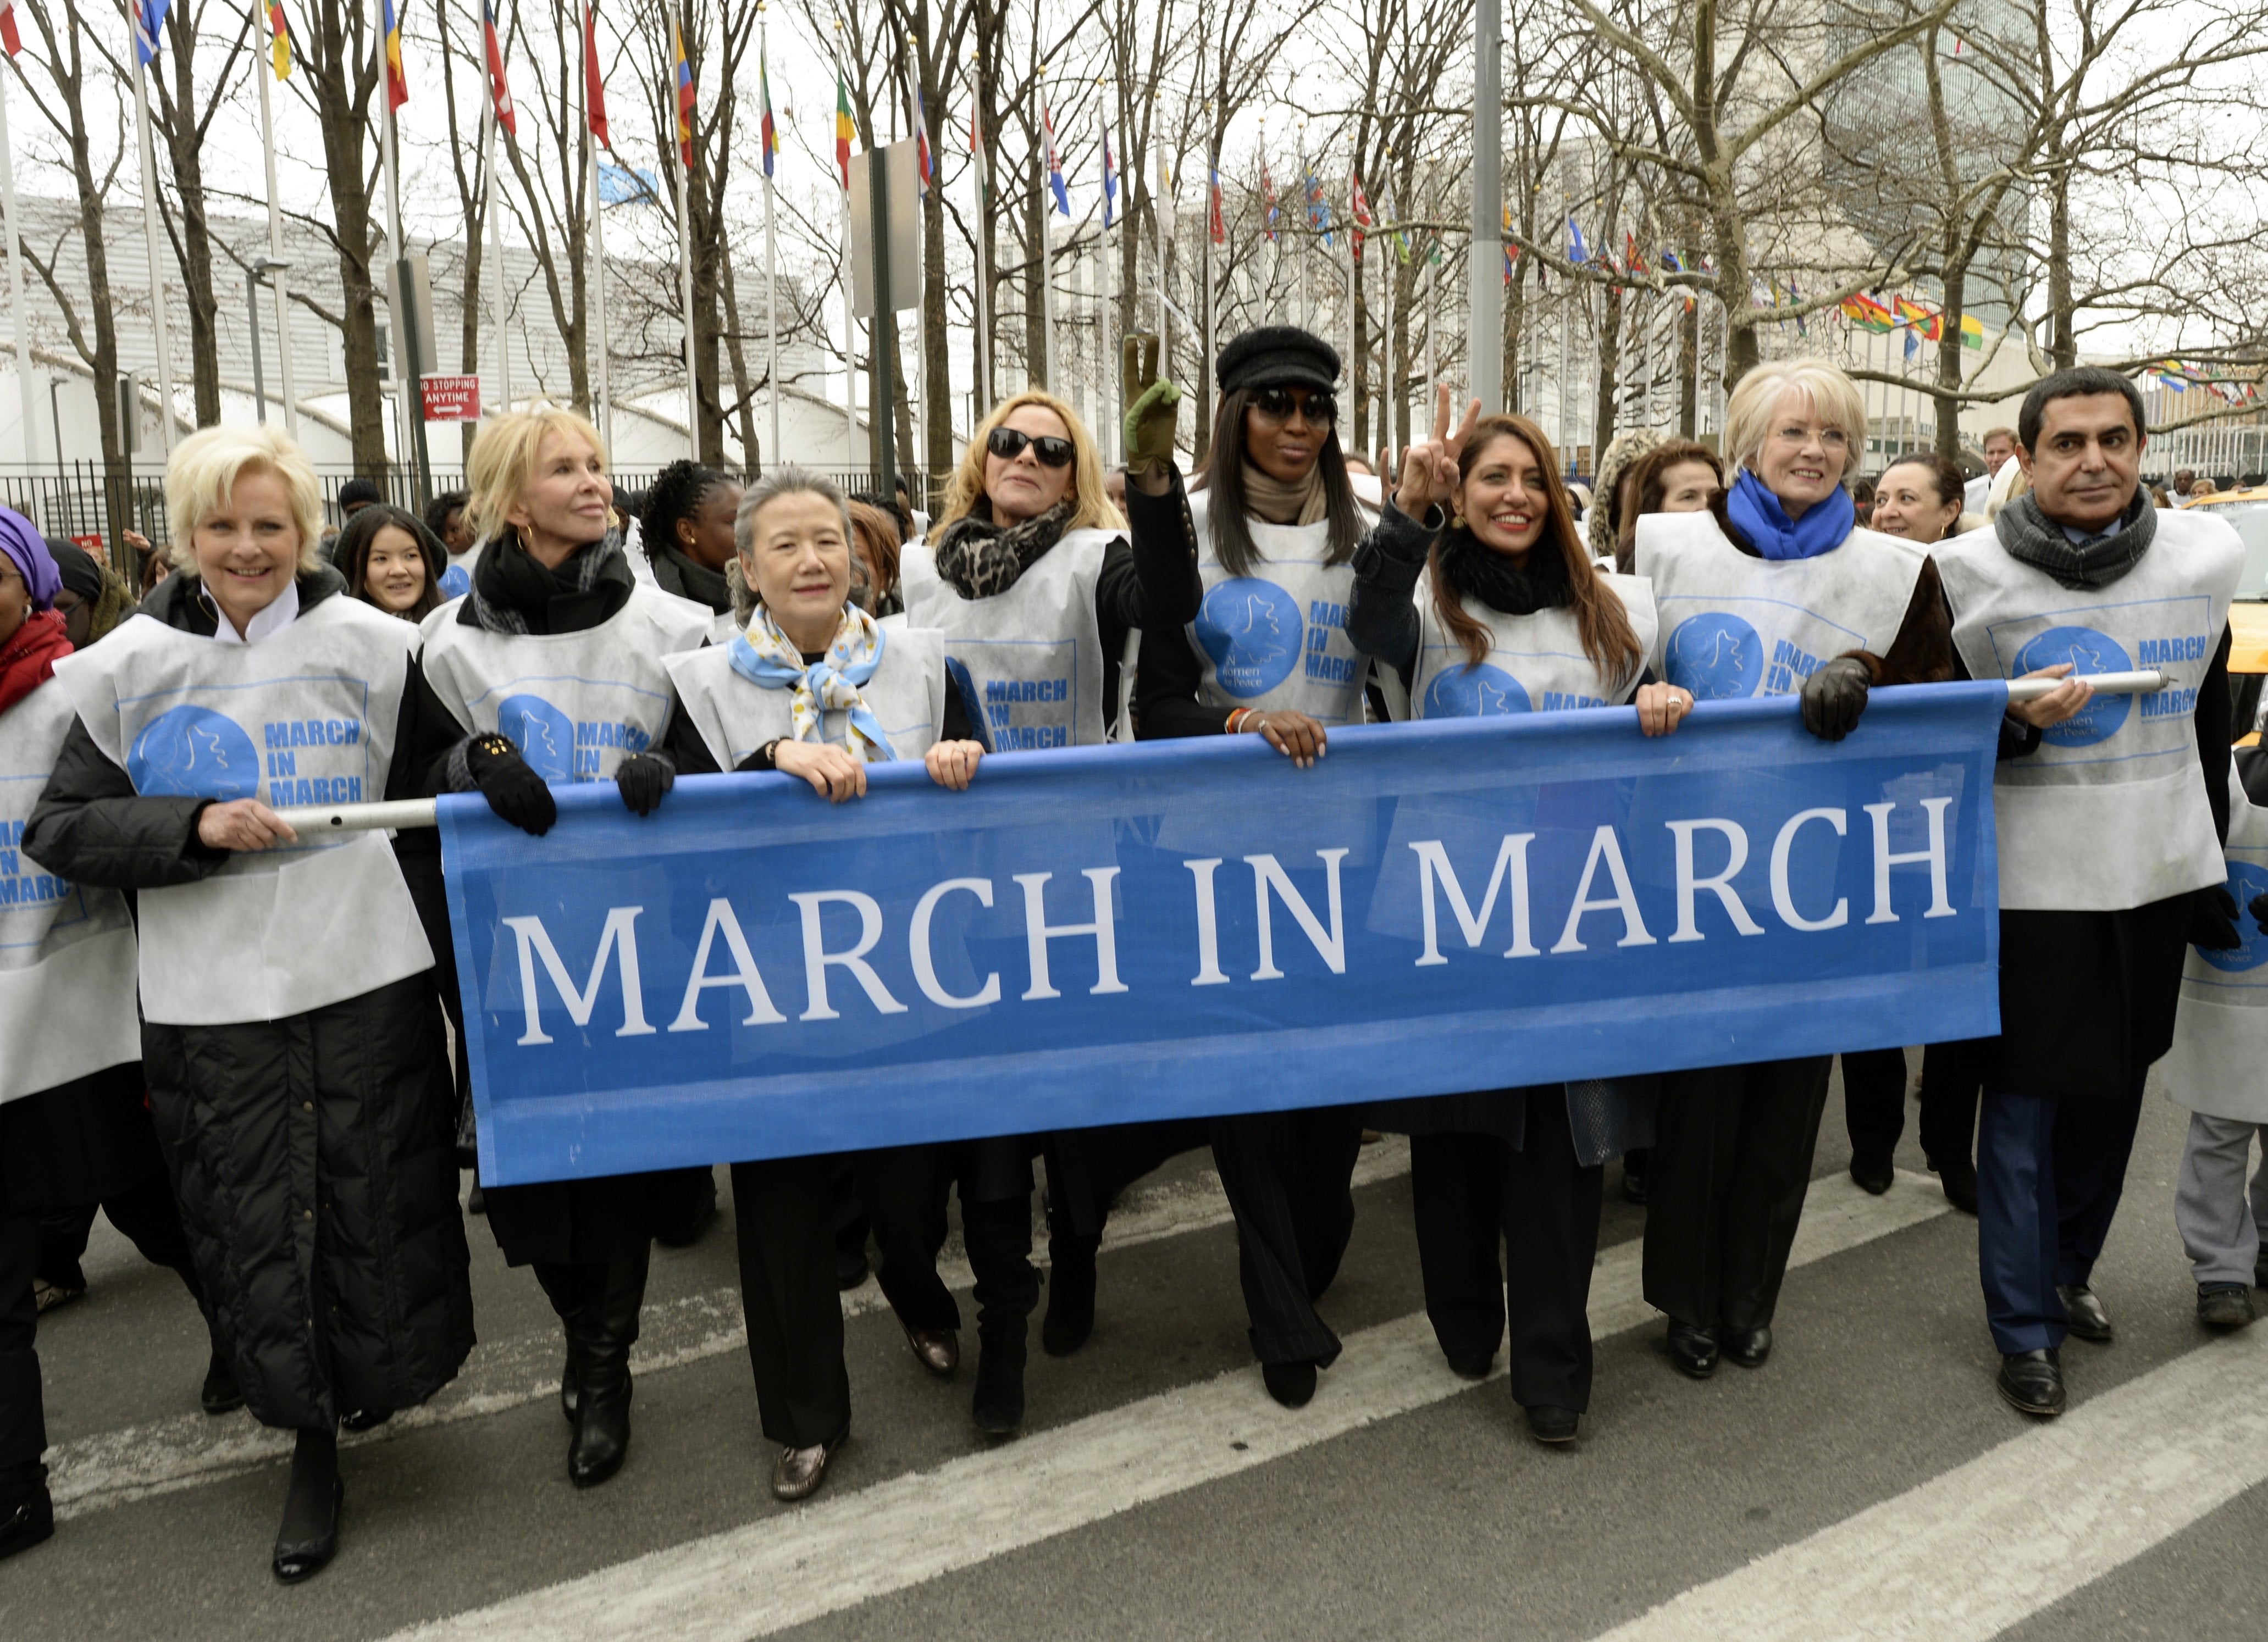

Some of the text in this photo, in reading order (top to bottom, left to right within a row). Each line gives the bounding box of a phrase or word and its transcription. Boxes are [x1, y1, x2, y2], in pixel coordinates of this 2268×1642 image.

[425, 391, 469, 404] ANYTIME
[433, 379, 475, 391] STOPPING
[1307, 627, 1328, 652] IN
[2139, 635, 2206, 664] MARCH
[987, 678, 1067, 702] MARCH
[1767, 664, 1792, 694] IN
[987, 704, 1010, 728] IN
[2140, 687, 2197, 717] MARCH
[264, 718, 361, 749] MARCH
[2053, 715, 2093, 727] omen
[577, 721, 650, 752] MARCH
[993, 725, 1067, 753] MARCH
[267, 750, 296, 778] IN
[576, 749, 600, 773] IN
[270, 776, 362, 807] MARCH
[0, 874, 72, 904] MARC
[501, 796, 1957, 1046] MARCH IN MARCH
